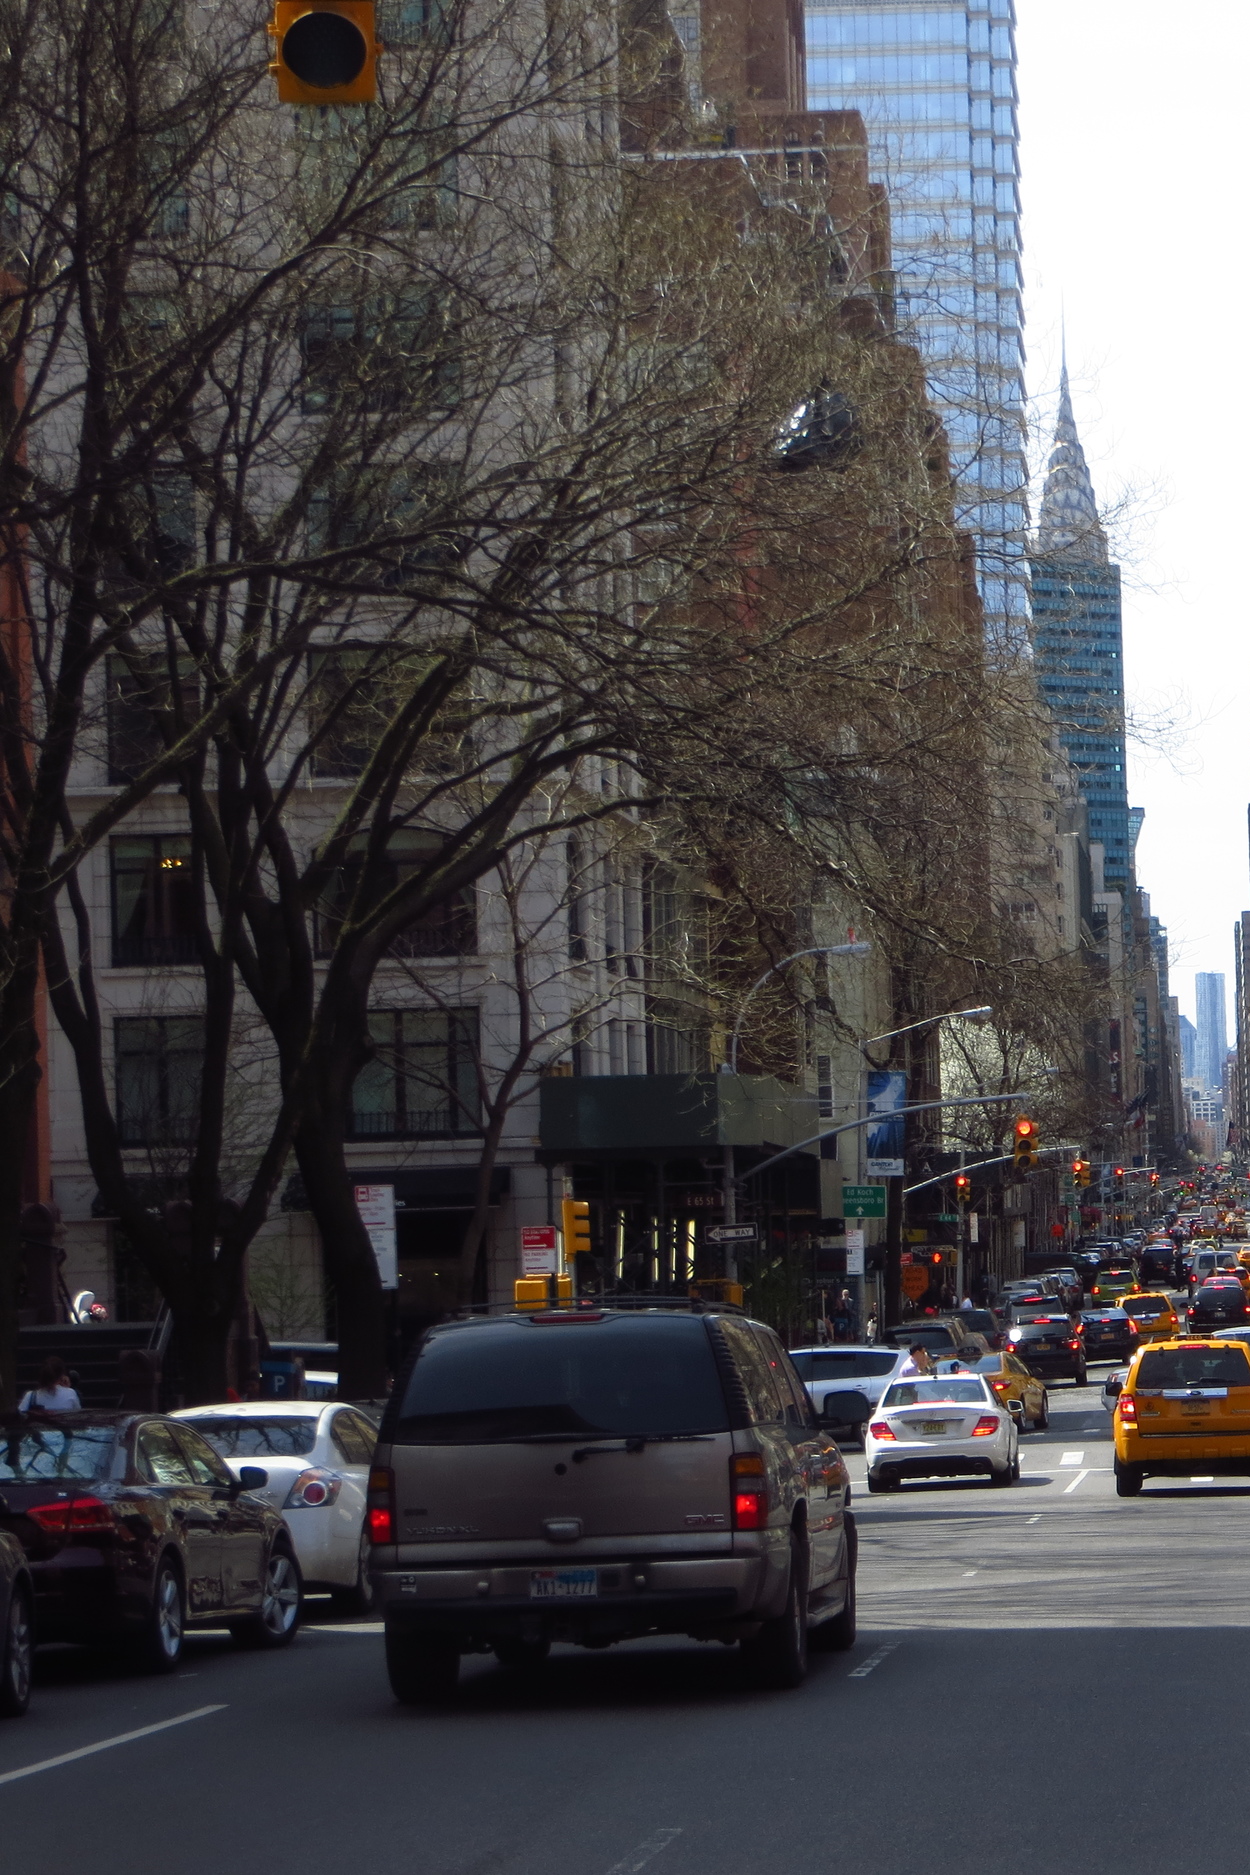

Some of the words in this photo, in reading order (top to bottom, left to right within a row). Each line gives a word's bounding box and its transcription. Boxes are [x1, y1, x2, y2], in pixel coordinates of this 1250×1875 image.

[846, 1188, 855, 1196] Ed
[857, 1188, 874, 1196] Koch
[687, 1197, 692, 1206] E
[713, 1230, 728, 1238] ONE
[734, 1229, 751, 1237] WAY
[273, 1375, 286, 1392] P
[685, 1513, 725, 1526] GMC
[405, 1525, 457, 1536] YUKON
[459, 1524, 481, 1534] XL
